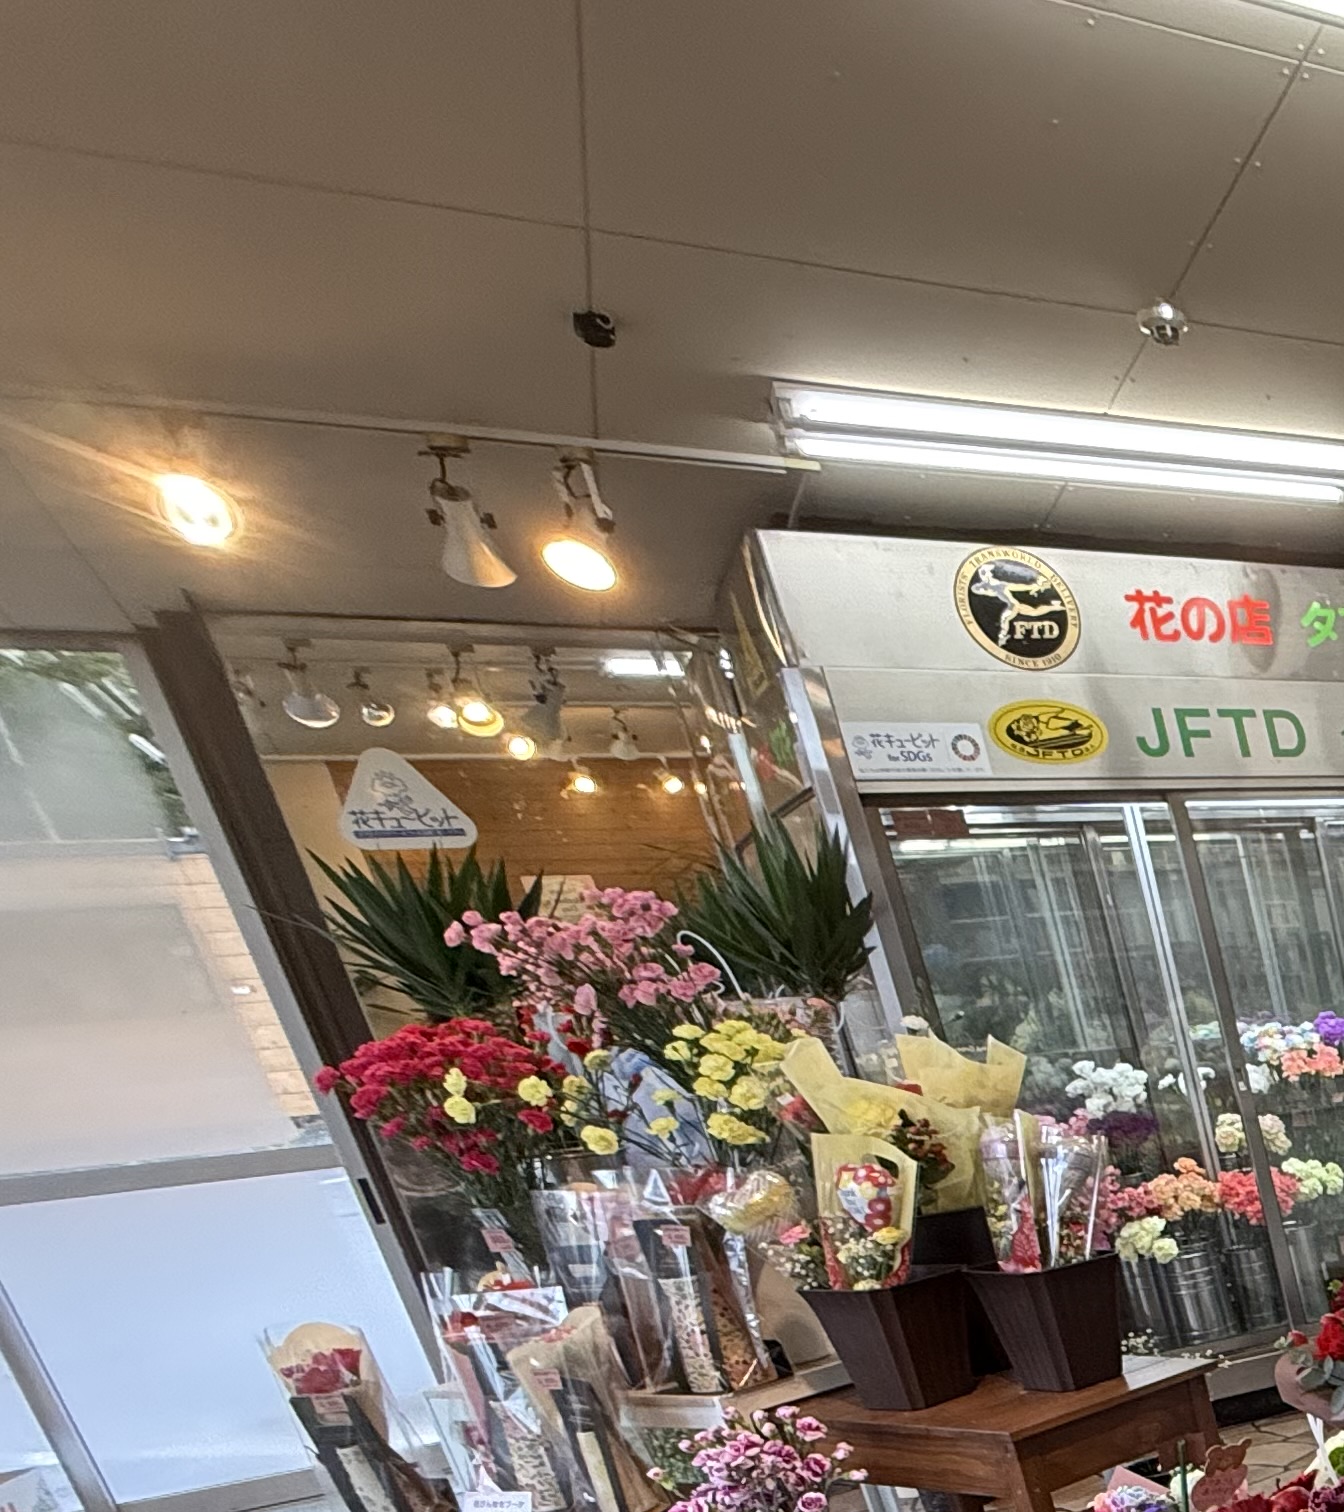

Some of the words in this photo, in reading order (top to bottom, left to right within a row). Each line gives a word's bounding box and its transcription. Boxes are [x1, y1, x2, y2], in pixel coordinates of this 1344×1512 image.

[1124, 589, 1273, 646] 花の店
[1013, 621, 1060, 639] FTD
[1005, 654, 1039, 667] SINCE
[870, 733, 940, 749] 花キューピット
[1136, 708, 1307, 758] JFTD
[902, 751, 933, 763] SDGs
[1025, 748, 1085, 759] JFTD
[348, 808, 459, 829] 花キューピット
